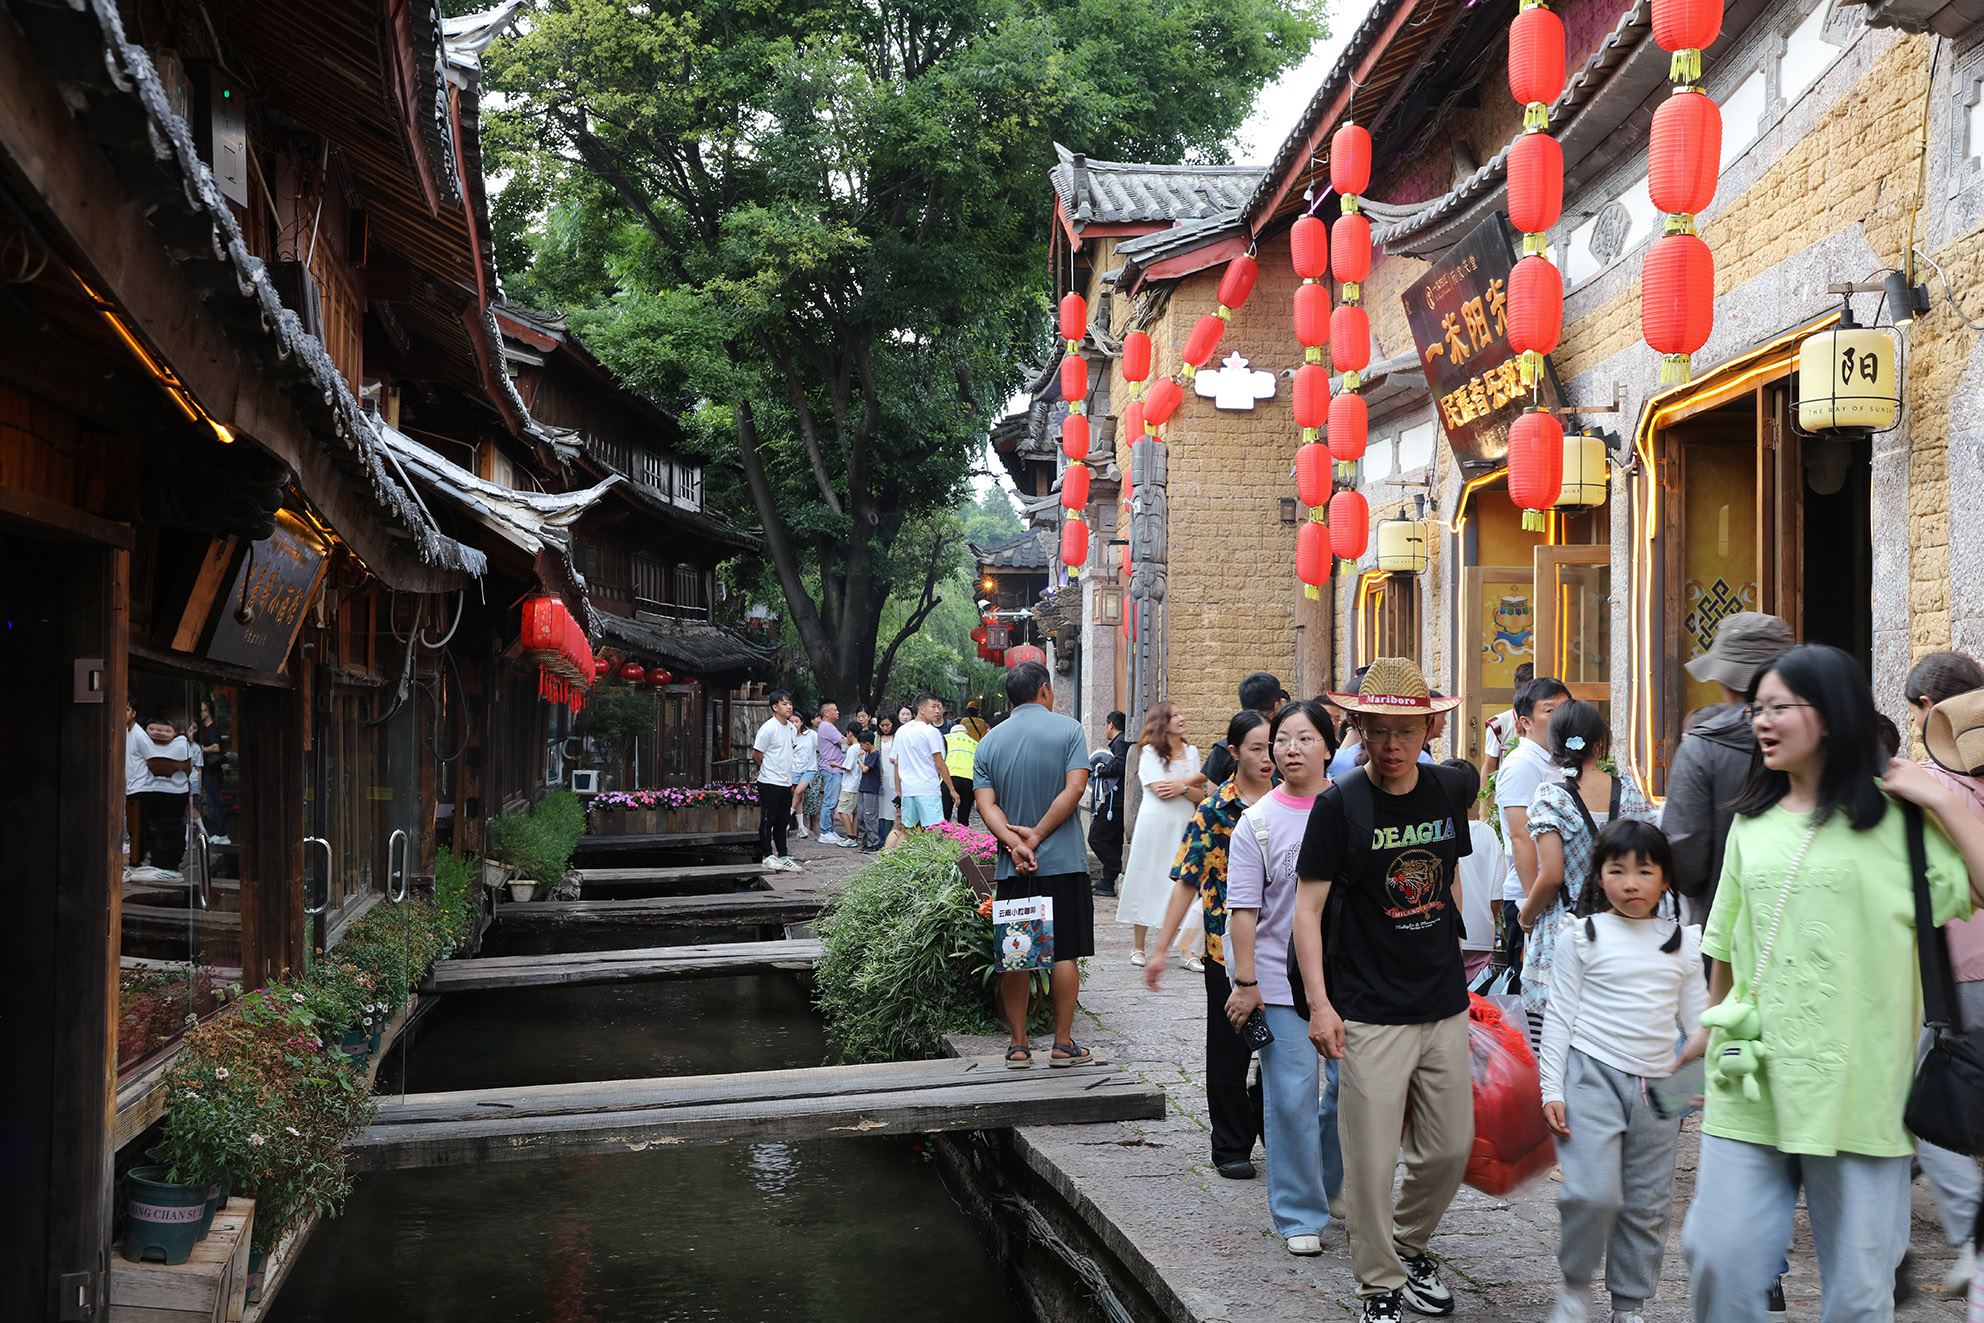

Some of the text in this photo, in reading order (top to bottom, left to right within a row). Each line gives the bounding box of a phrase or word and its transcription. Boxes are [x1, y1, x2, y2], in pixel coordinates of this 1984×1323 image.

[1425, 278, 1507, 365] 一米阳光
[1841, 347, 1878, 385] 阳
[1440, 355, 1538, 430] 民谣音乐现
[1395, 907, 1420, 918] MILANO
[154, 1209, 184, 1220] CHAN
